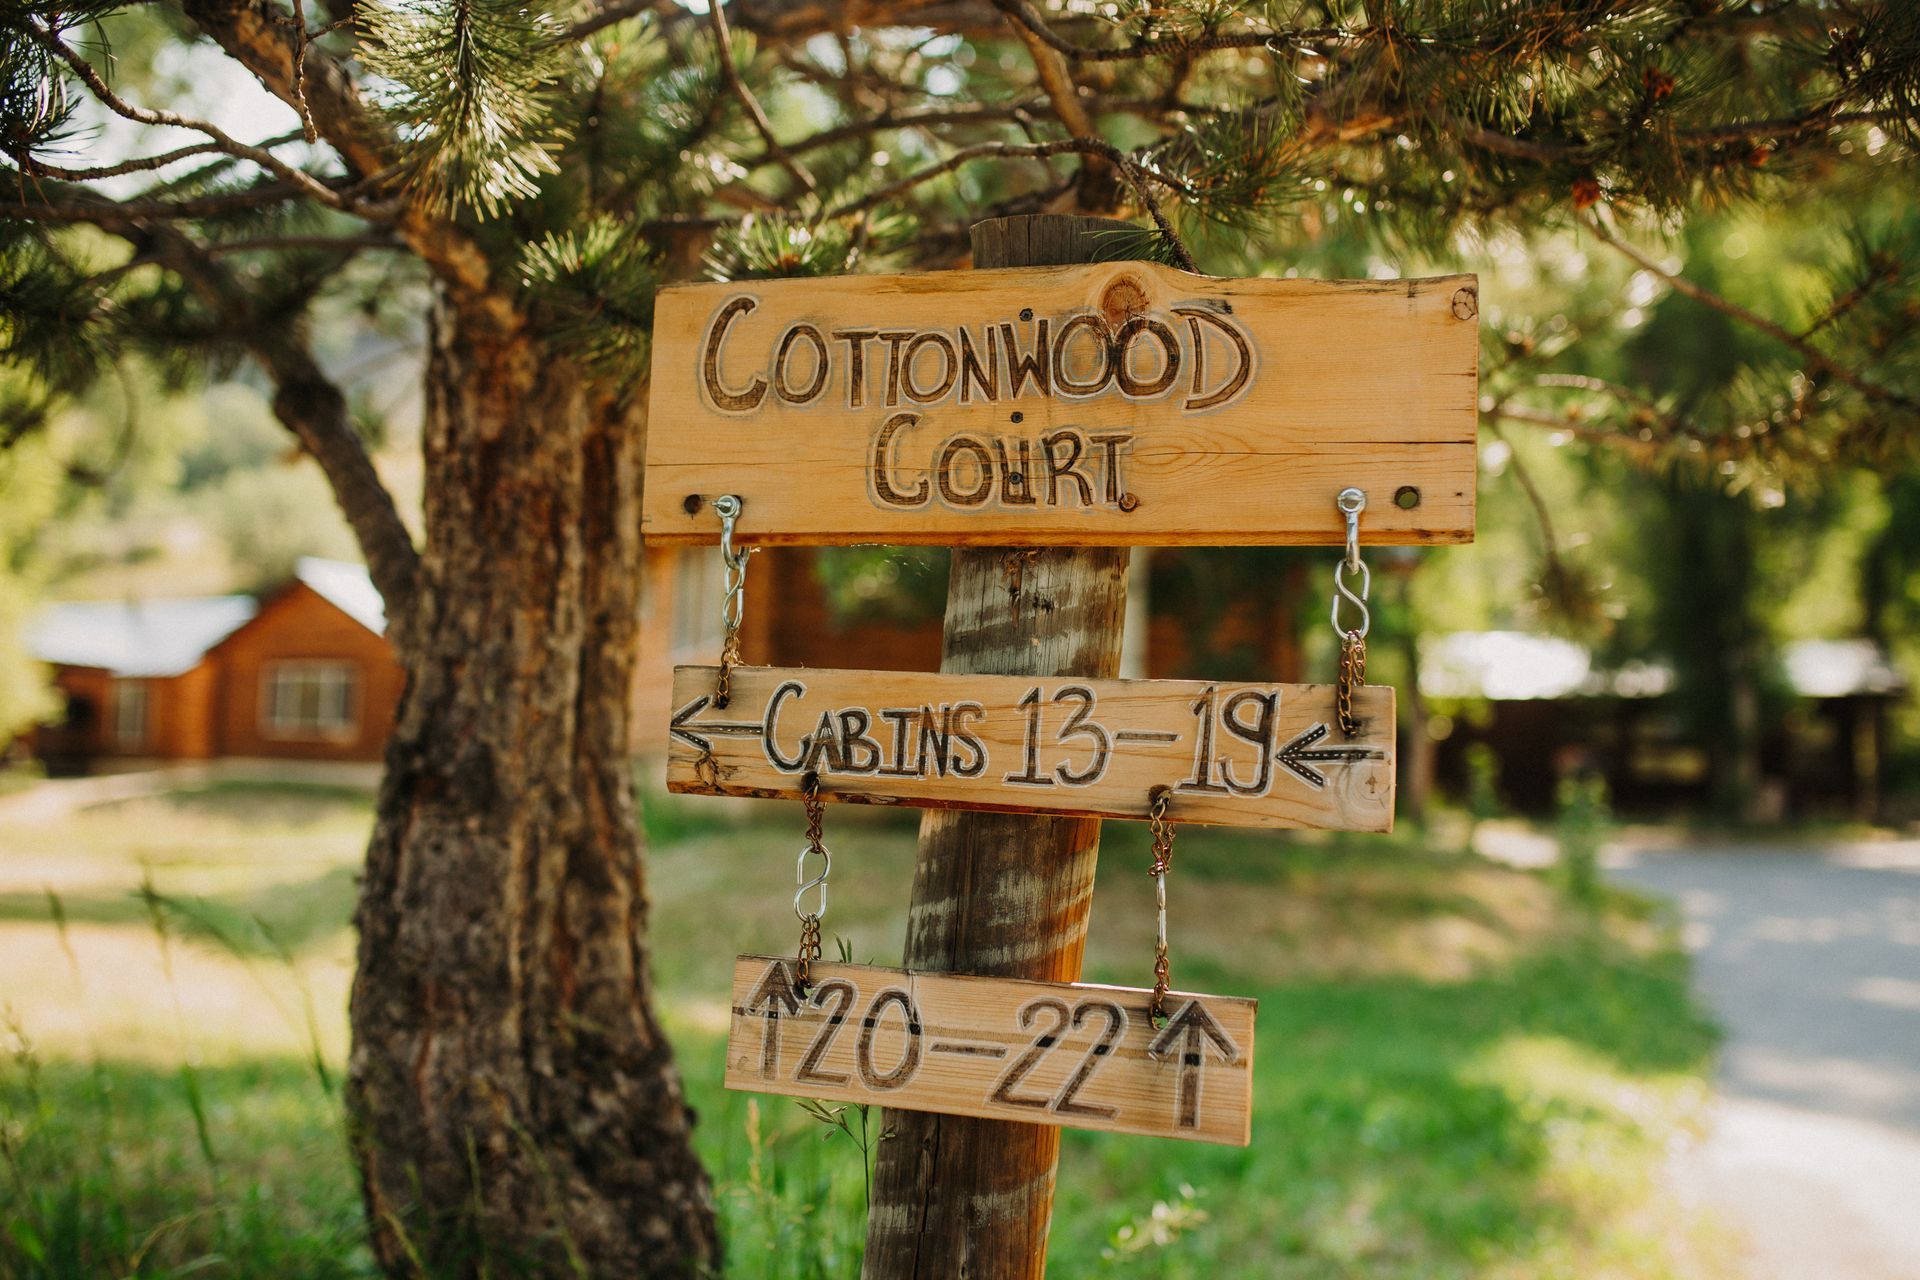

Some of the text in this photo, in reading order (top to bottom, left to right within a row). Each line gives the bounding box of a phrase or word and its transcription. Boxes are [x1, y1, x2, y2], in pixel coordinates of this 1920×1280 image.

[703, 296, 1254, 411] COTTONWOOD
[873, 413, 1134, 507] COURT
[764, 683, 987, 778] CABINS
